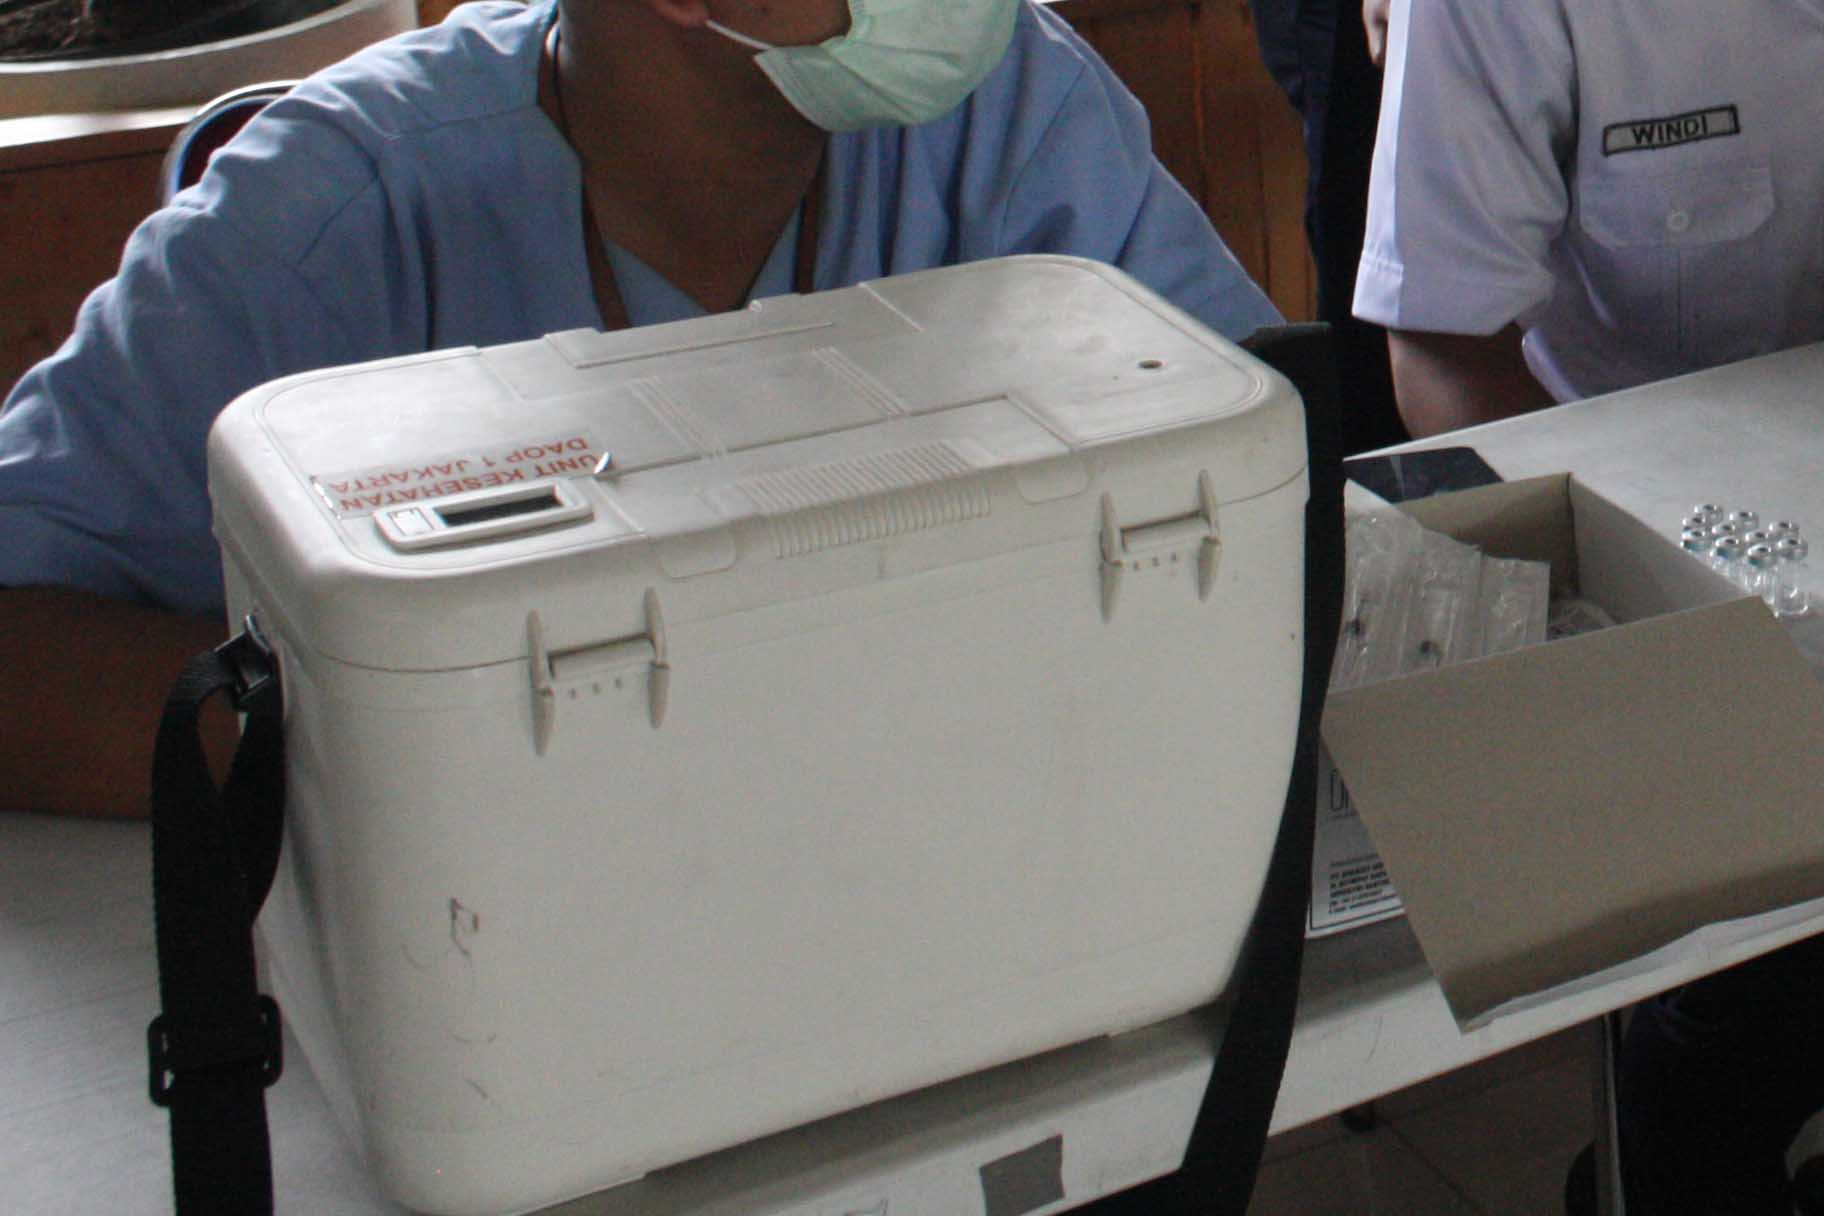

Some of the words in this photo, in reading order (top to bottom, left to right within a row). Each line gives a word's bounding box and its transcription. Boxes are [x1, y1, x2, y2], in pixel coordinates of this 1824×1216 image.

[1630, 114, 1709, 145] WINDI
[480, 454, 497, 468] 1
[505, 437, 589, 464] DAOP
[535, 453, 600, 477] UNIT
[331, 458, 467, 494] JAKARTA
[340, 468, 525, 511] KESEHATAN
